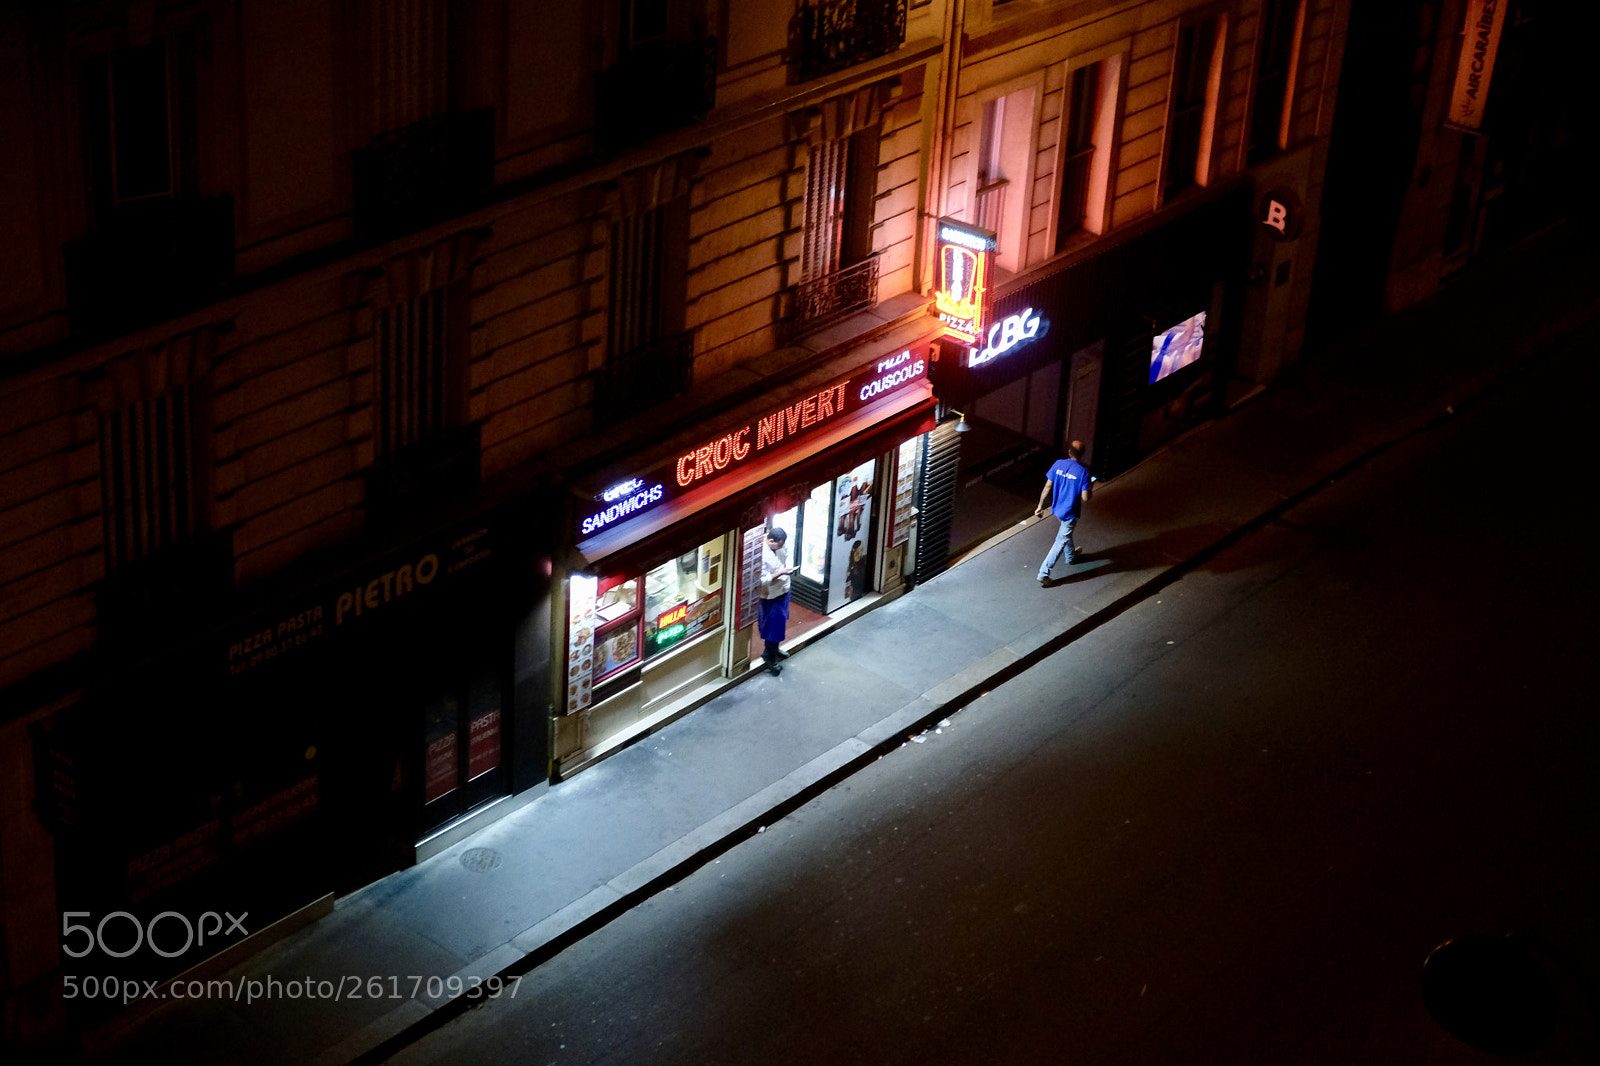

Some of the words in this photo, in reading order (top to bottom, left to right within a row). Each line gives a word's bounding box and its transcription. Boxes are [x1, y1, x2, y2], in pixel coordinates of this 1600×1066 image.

[859, 359, 925, 401] COUSCOUS
[676, 425, 750, 487] CROC
[757, 380, 850, 450] NIVERT
[581, 483, 663, 535] SANDWICHS
[336, 552, 439, 626] PIETRO
[228, 627, 273, 661] PIZZA
[277, 604, 324, 639] PASTA
[128, 844, 171, 878] PIZZA
[174, 817, 221, 854] PASTA
